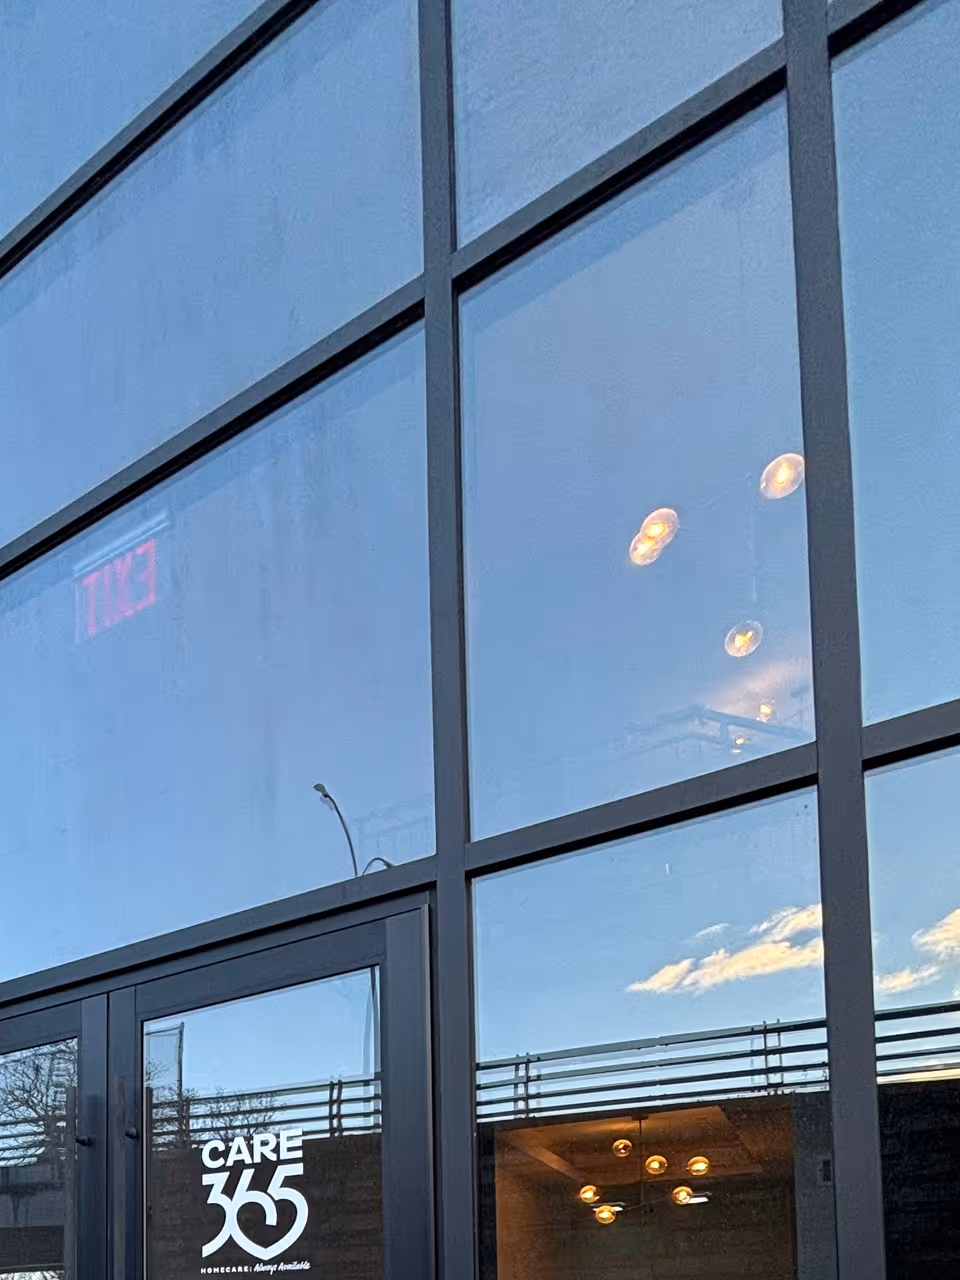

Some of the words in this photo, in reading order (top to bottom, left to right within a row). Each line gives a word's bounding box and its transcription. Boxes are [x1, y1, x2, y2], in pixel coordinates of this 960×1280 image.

[201, 1128, 303, 1169] CARE
[201, 1162, 309, 1260] 365
[253, 1262, 278, 1275] Always
[278, 1260, 311, 1272] Available
